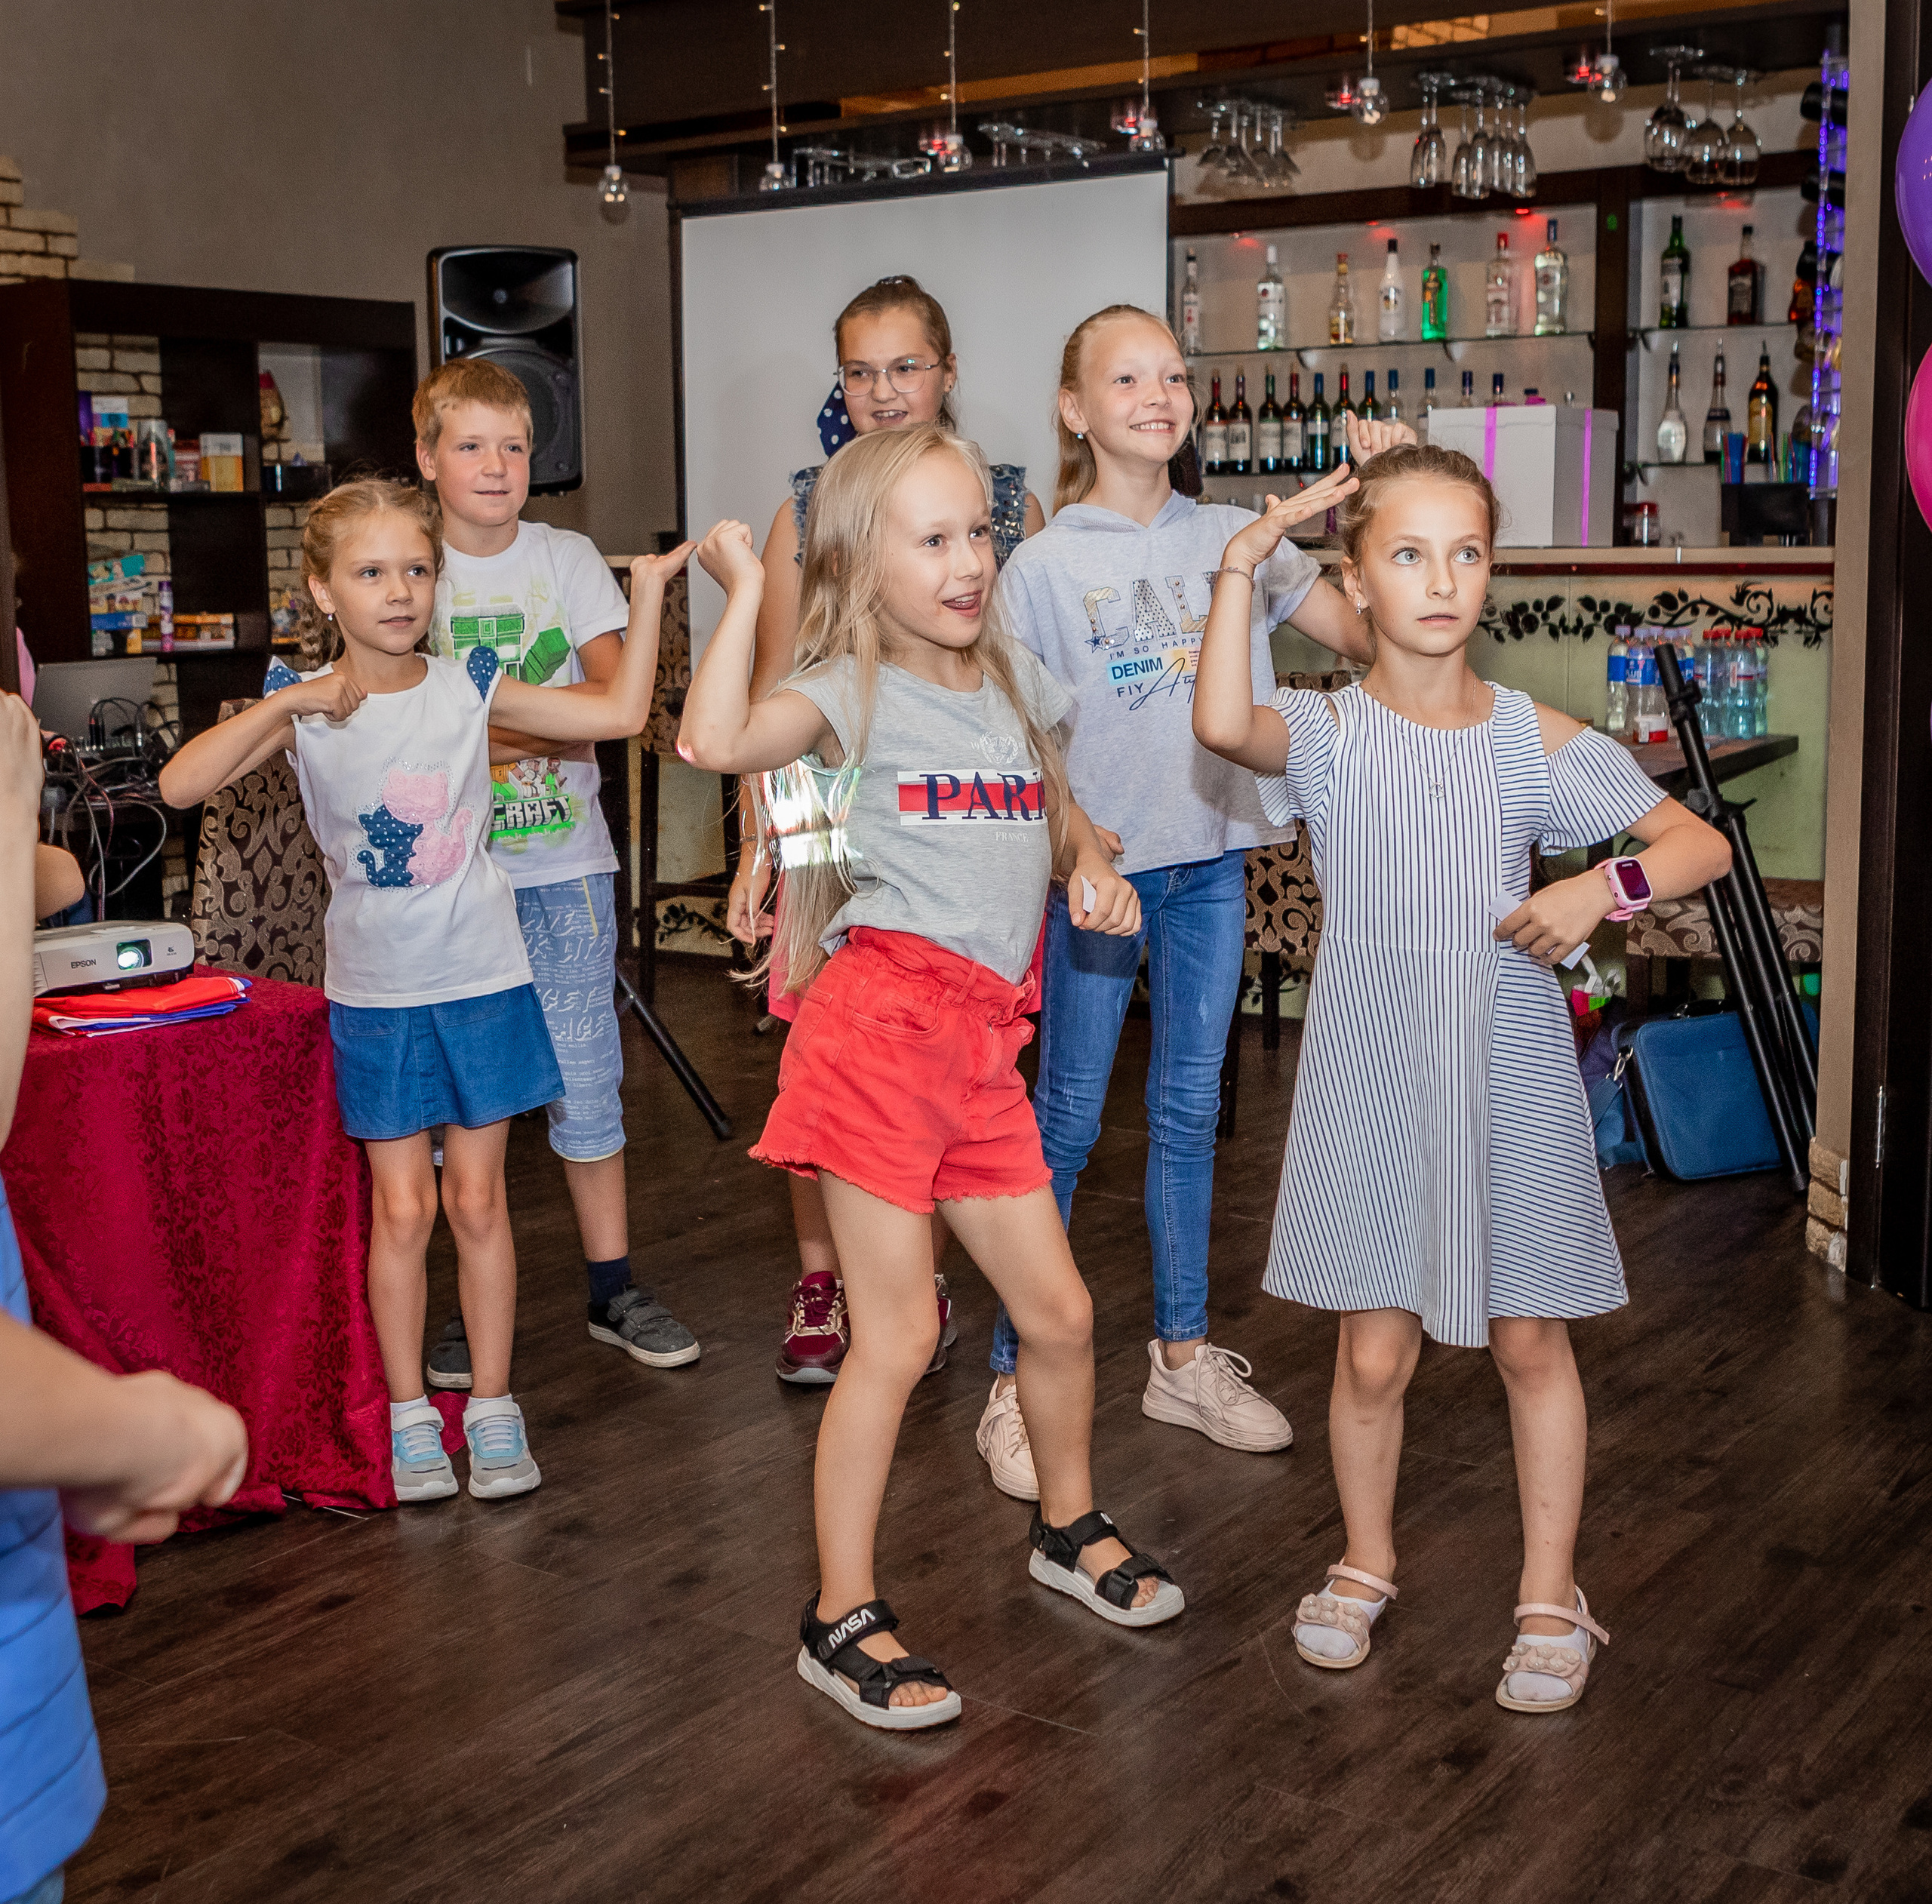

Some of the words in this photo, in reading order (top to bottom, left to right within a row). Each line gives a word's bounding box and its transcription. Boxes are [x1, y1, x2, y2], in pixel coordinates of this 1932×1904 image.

[1134, 645, 1149, 654] SO
[1111, 657, 1163, 680] DENIM
[919, 771, 1047, 822] PARI
[491, 795, 571, 832] CRAFT
[995, 831, 1029, 843] FRANCE
[70, 958, 97, 969] EPSON
[828, 1608, 875, 1650] NASA
